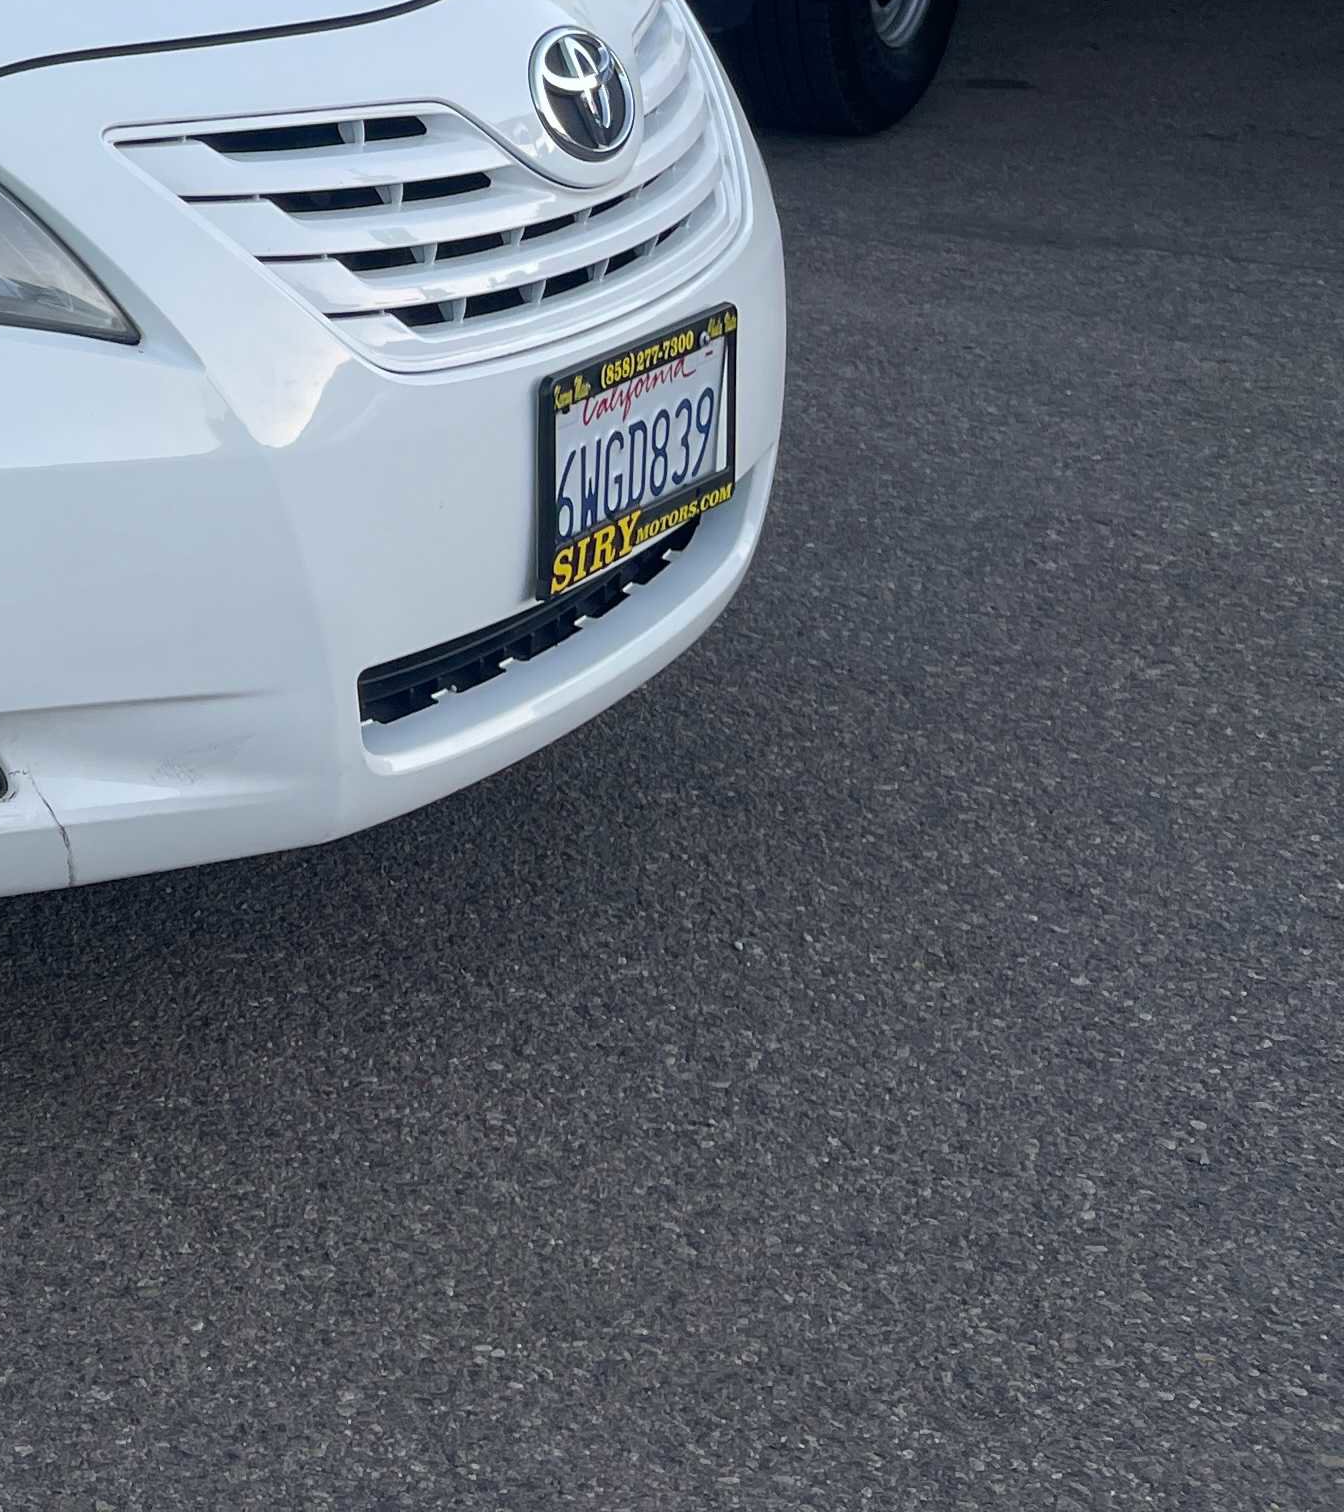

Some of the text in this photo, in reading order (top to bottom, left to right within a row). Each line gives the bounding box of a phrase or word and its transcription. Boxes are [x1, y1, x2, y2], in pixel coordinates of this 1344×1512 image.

[581, 355, 696, 426] California
[557, 387, 714, 539] 6WGD839
[550, 483, 733, 595] SIRY MOTORS.COM
